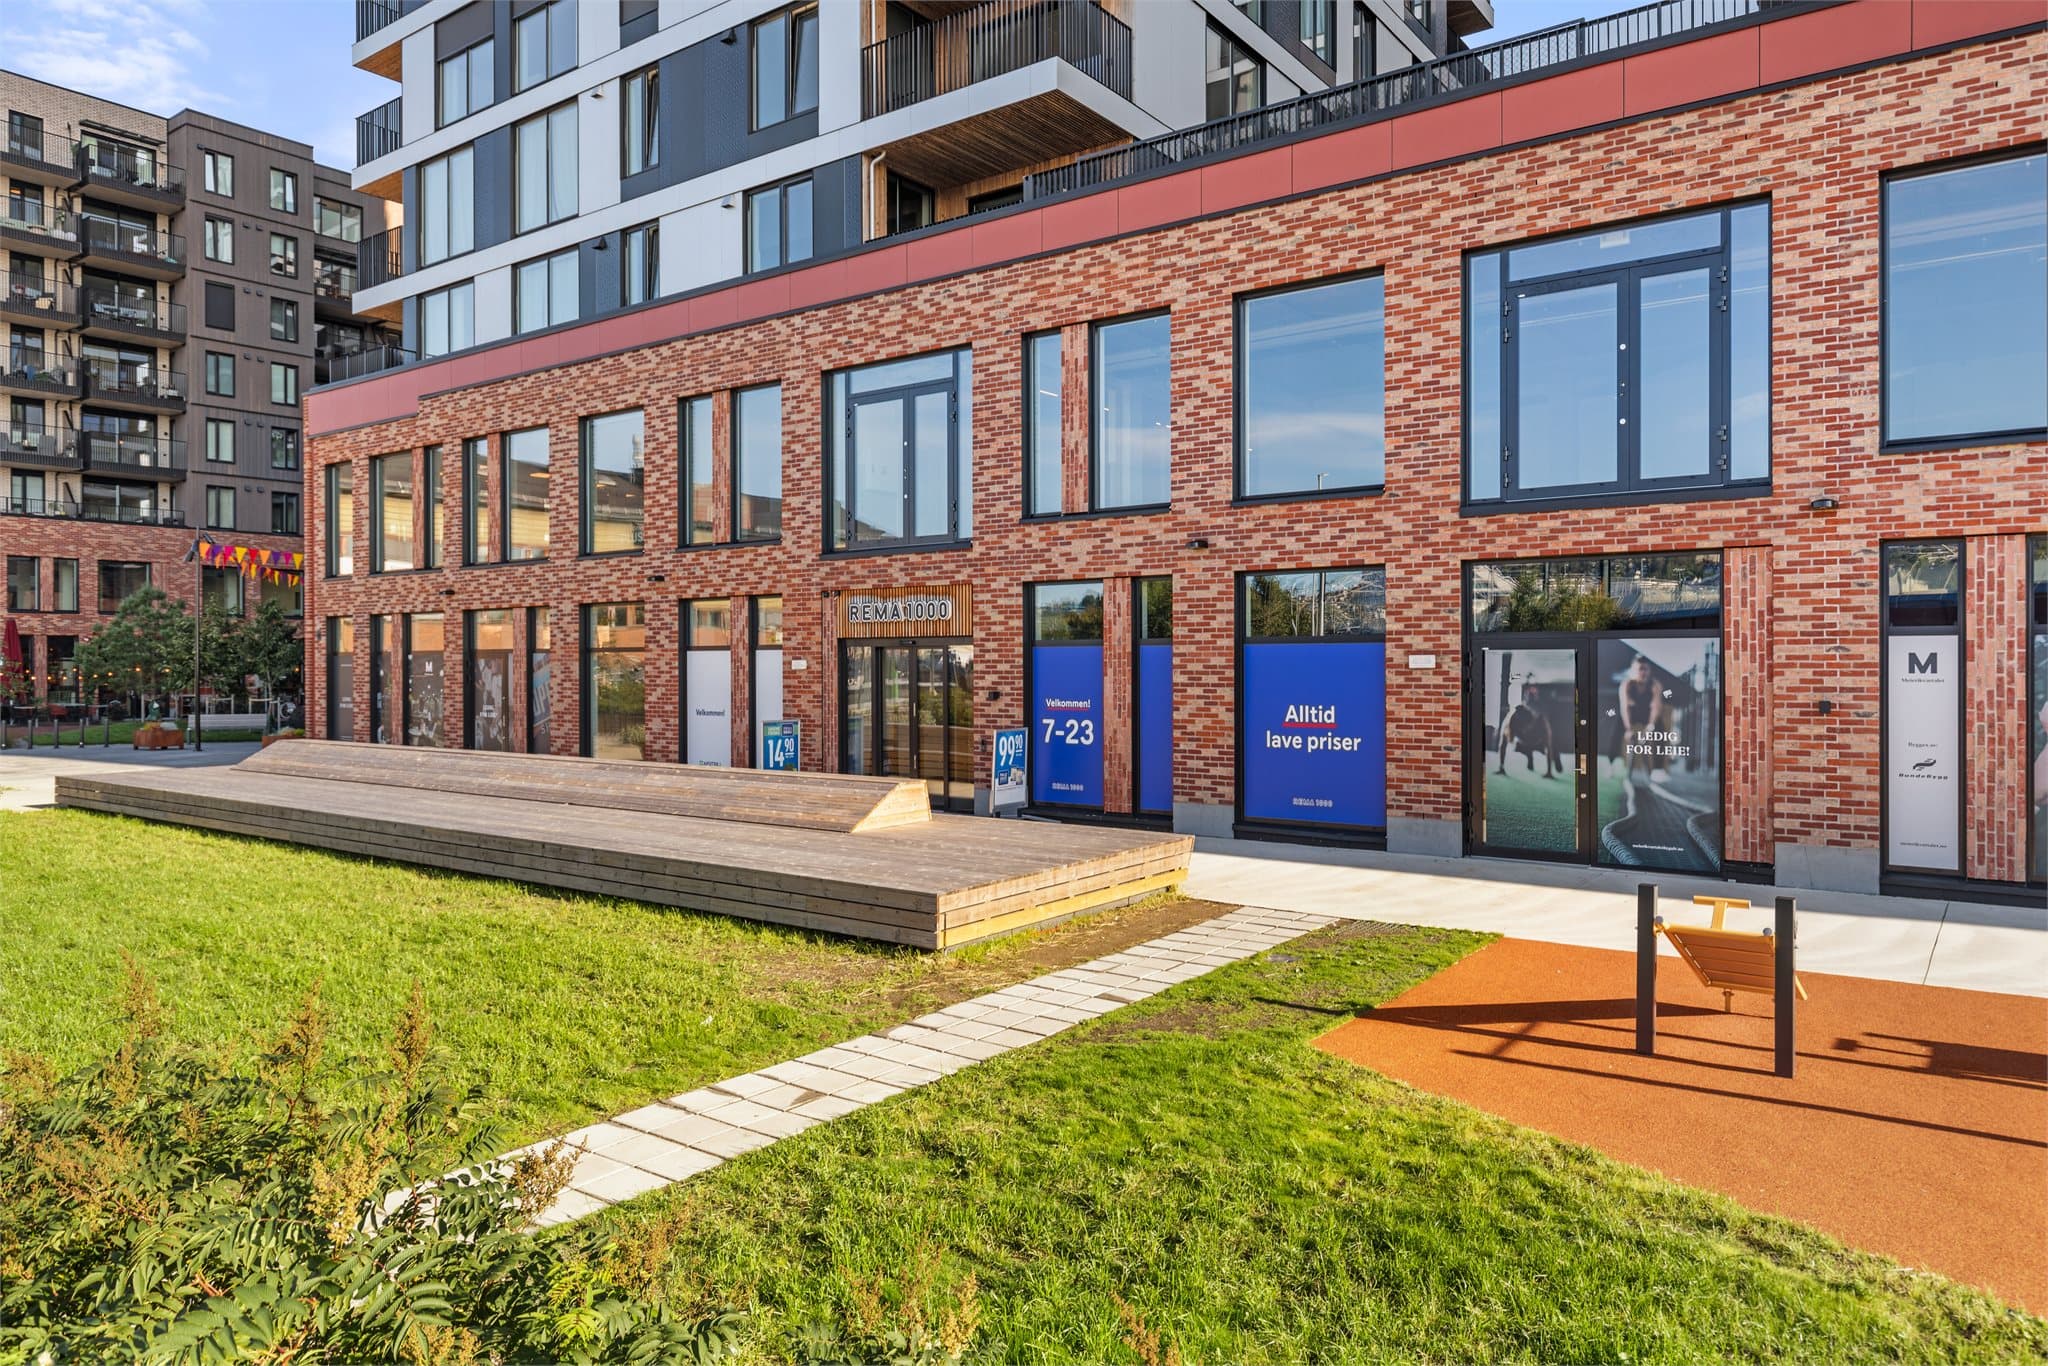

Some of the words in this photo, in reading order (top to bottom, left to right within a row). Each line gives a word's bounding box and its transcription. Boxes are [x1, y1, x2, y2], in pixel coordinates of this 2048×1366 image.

[849, 603, 902, 622] REMA
[906, 601, 952, 621] 1000
[1908, 652, 1938, 674] M
[1045, 698, 1091, 708] Velkommen!
[1285, 704, 1335, 723] Alltid
[1042, 718, 1095, 745] 7-23
[1266, 730, 1303, 750] lave
[1307, 731, 1362, 753] priser
[1637, 731, 1678, 742] LEDIG
[767, 738, 785, 769] 14
[784, 737, 795, 752] 90
[998, 735, 1015, 767] 99
[1626, 744, 1653, 755] FOR
[1656, 746, 1691, 757] LEIE!
